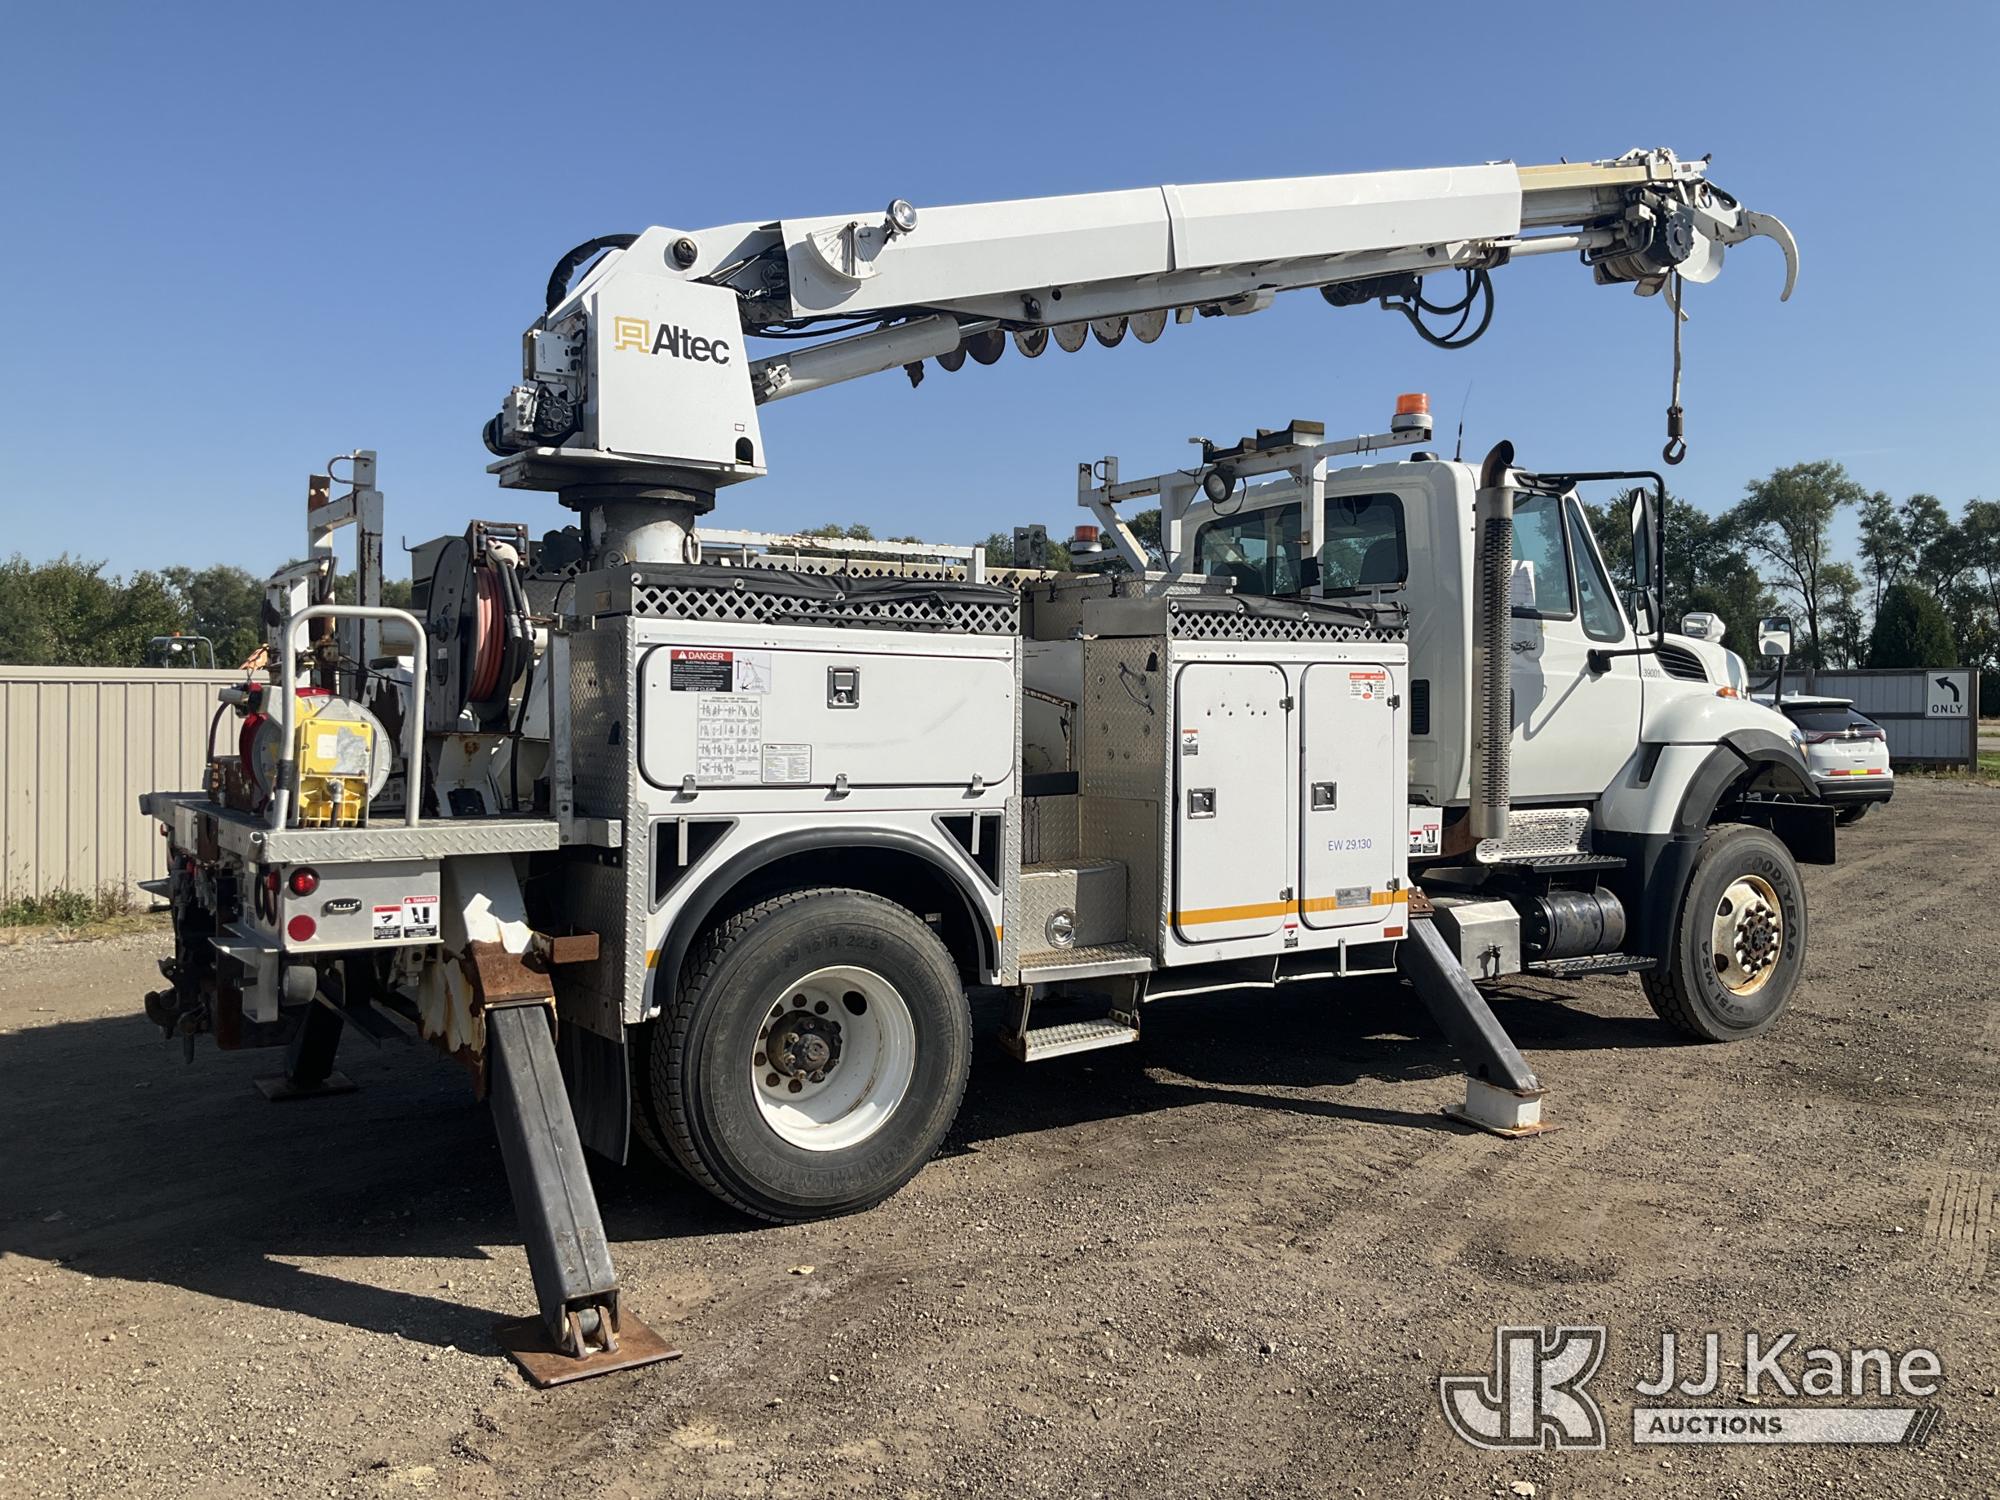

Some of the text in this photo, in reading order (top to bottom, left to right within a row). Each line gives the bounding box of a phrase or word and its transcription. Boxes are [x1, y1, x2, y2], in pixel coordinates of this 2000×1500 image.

[651, 323, 730, 365] Altec
[688, 651, 724, 661] DANGER
[1932, 704, 1963, 714] ONLY
[1328, 840, 1343, 851] EW
